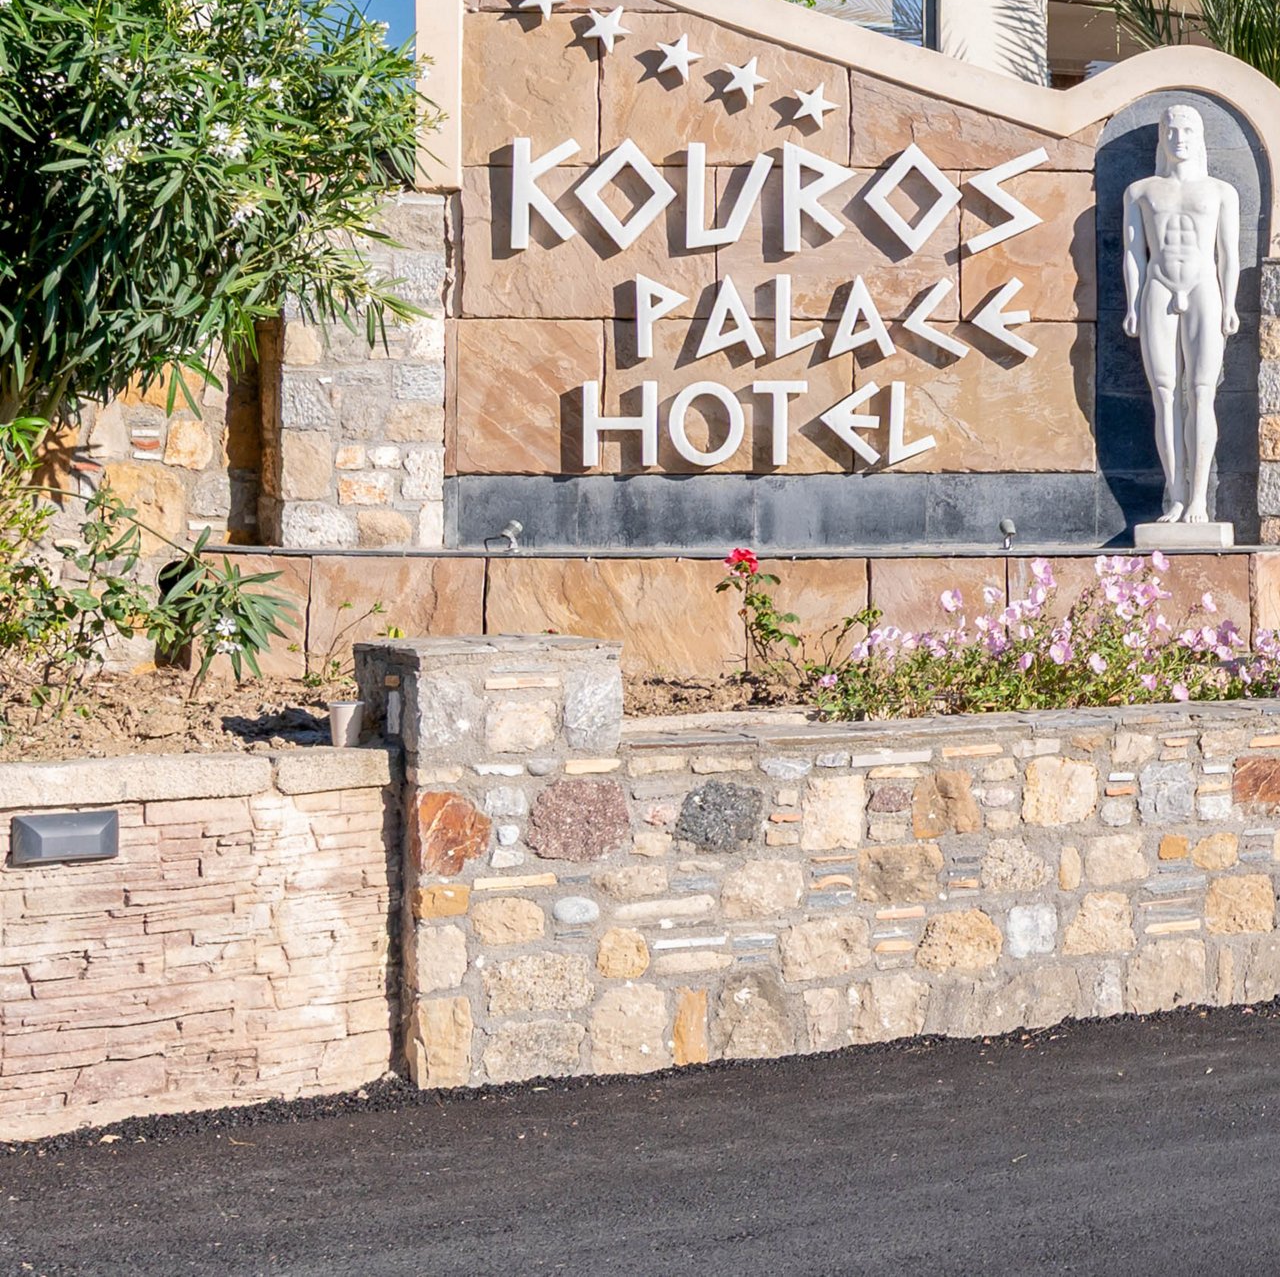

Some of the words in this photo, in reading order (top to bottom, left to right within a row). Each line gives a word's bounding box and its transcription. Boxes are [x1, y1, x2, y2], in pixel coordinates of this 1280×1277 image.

[510, 137, 1050, 254] KOUROS
[636, 274, 1038, 359] PALACE
[583, 380, 936, 466] HOTEL
